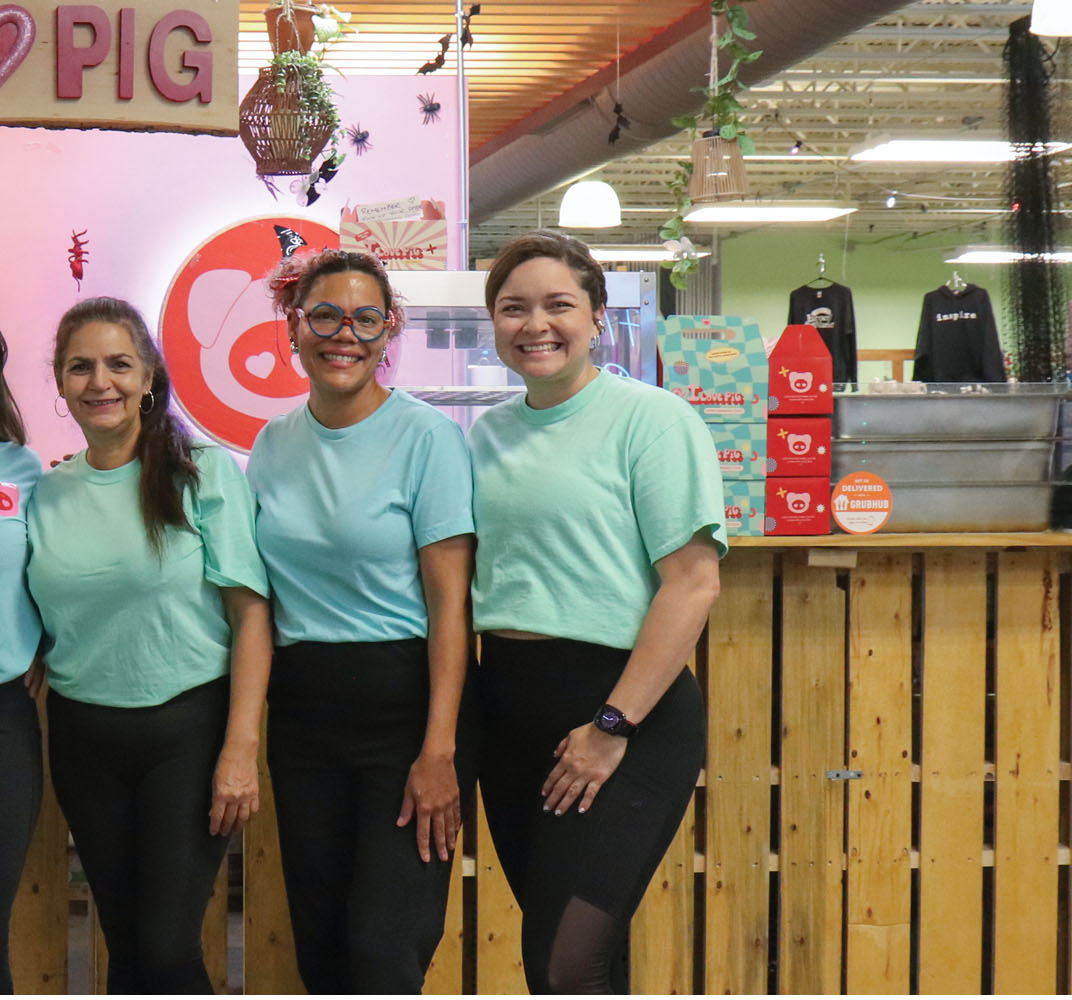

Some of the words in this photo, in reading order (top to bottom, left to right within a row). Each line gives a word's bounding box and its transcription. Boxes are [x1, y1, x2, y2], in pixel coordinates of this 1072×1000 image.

[56, 5, 213, 104] PIG
[936, 312, 977, 322] inspire
[725, 390, 745, 405] PIG
[841, 484, 884, 492] DELIVERED
[850, 499, 889, 509] GRUBHUB
